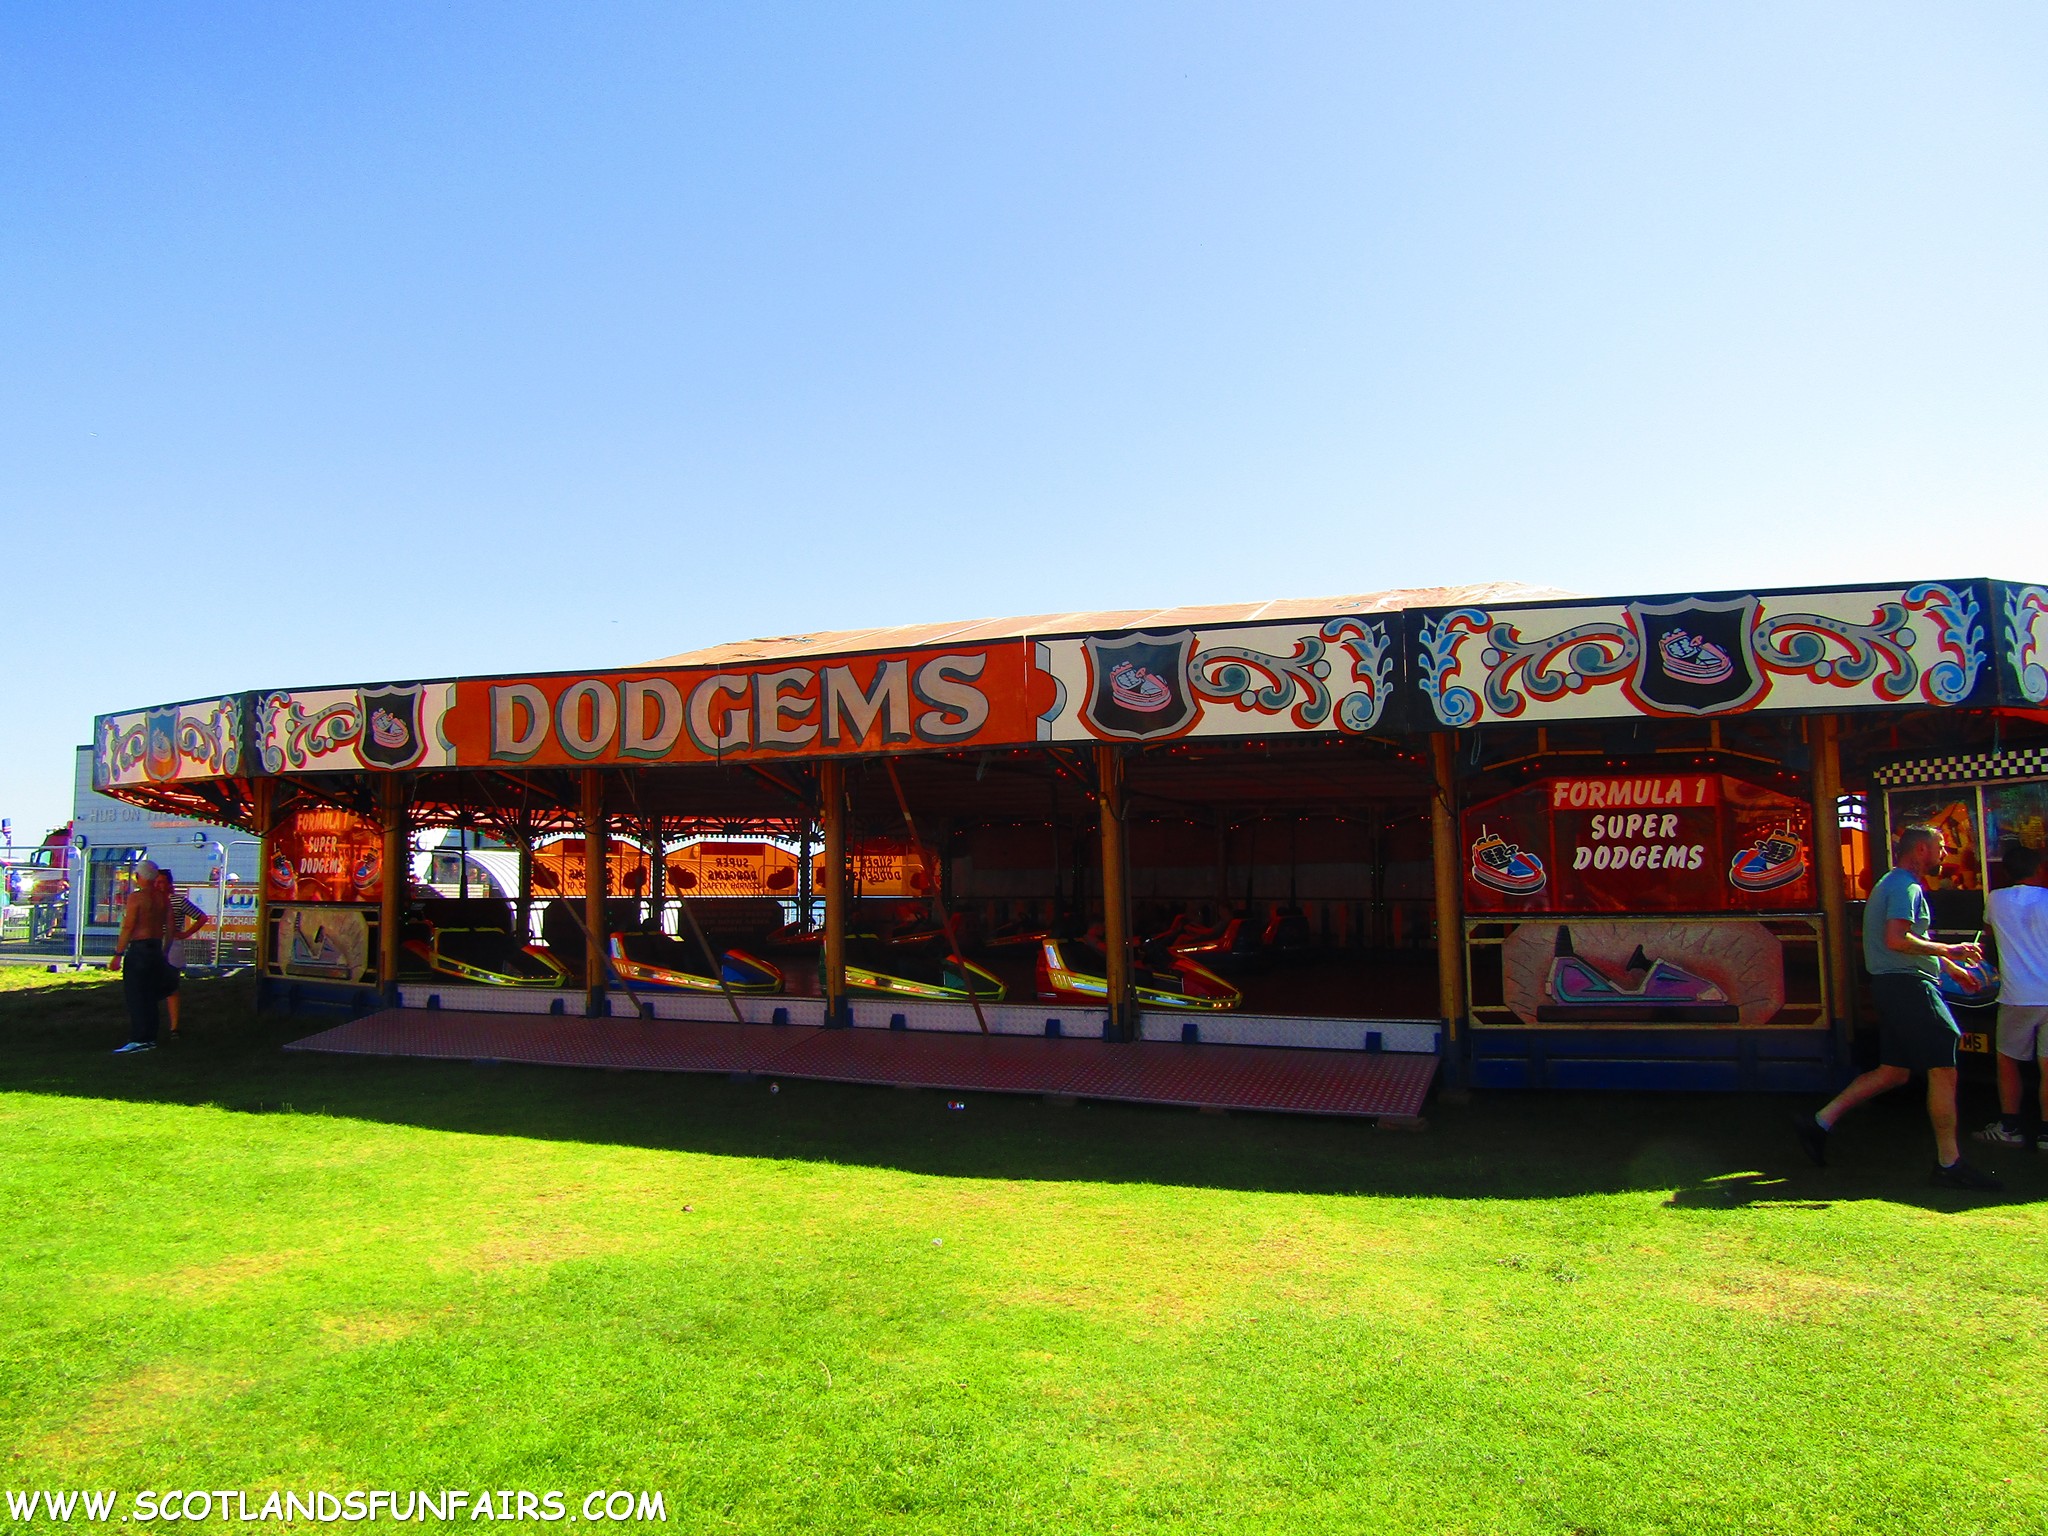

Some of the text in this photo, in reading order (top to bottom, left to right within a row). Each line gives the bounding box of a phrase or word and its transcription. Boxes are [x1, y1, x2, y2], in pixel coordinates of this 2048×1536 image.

[488, 653, 990, 761] DODGEMS
[1553, 778, 1706, 807] FORMULA 1
[91, 809, 117, 822] HUB
[122, 808, 141, 821] ON
[298, 812, 342, 831] FORMULA
[1591, 814, 1678, 840] SUPER
[309, 836, 338, 853] SUPER
[301, 858, 342, 873] DODGEMS
[1572, 845, 1705, 870] DODGEMS
[237, 932, 257, 941] HIRE
